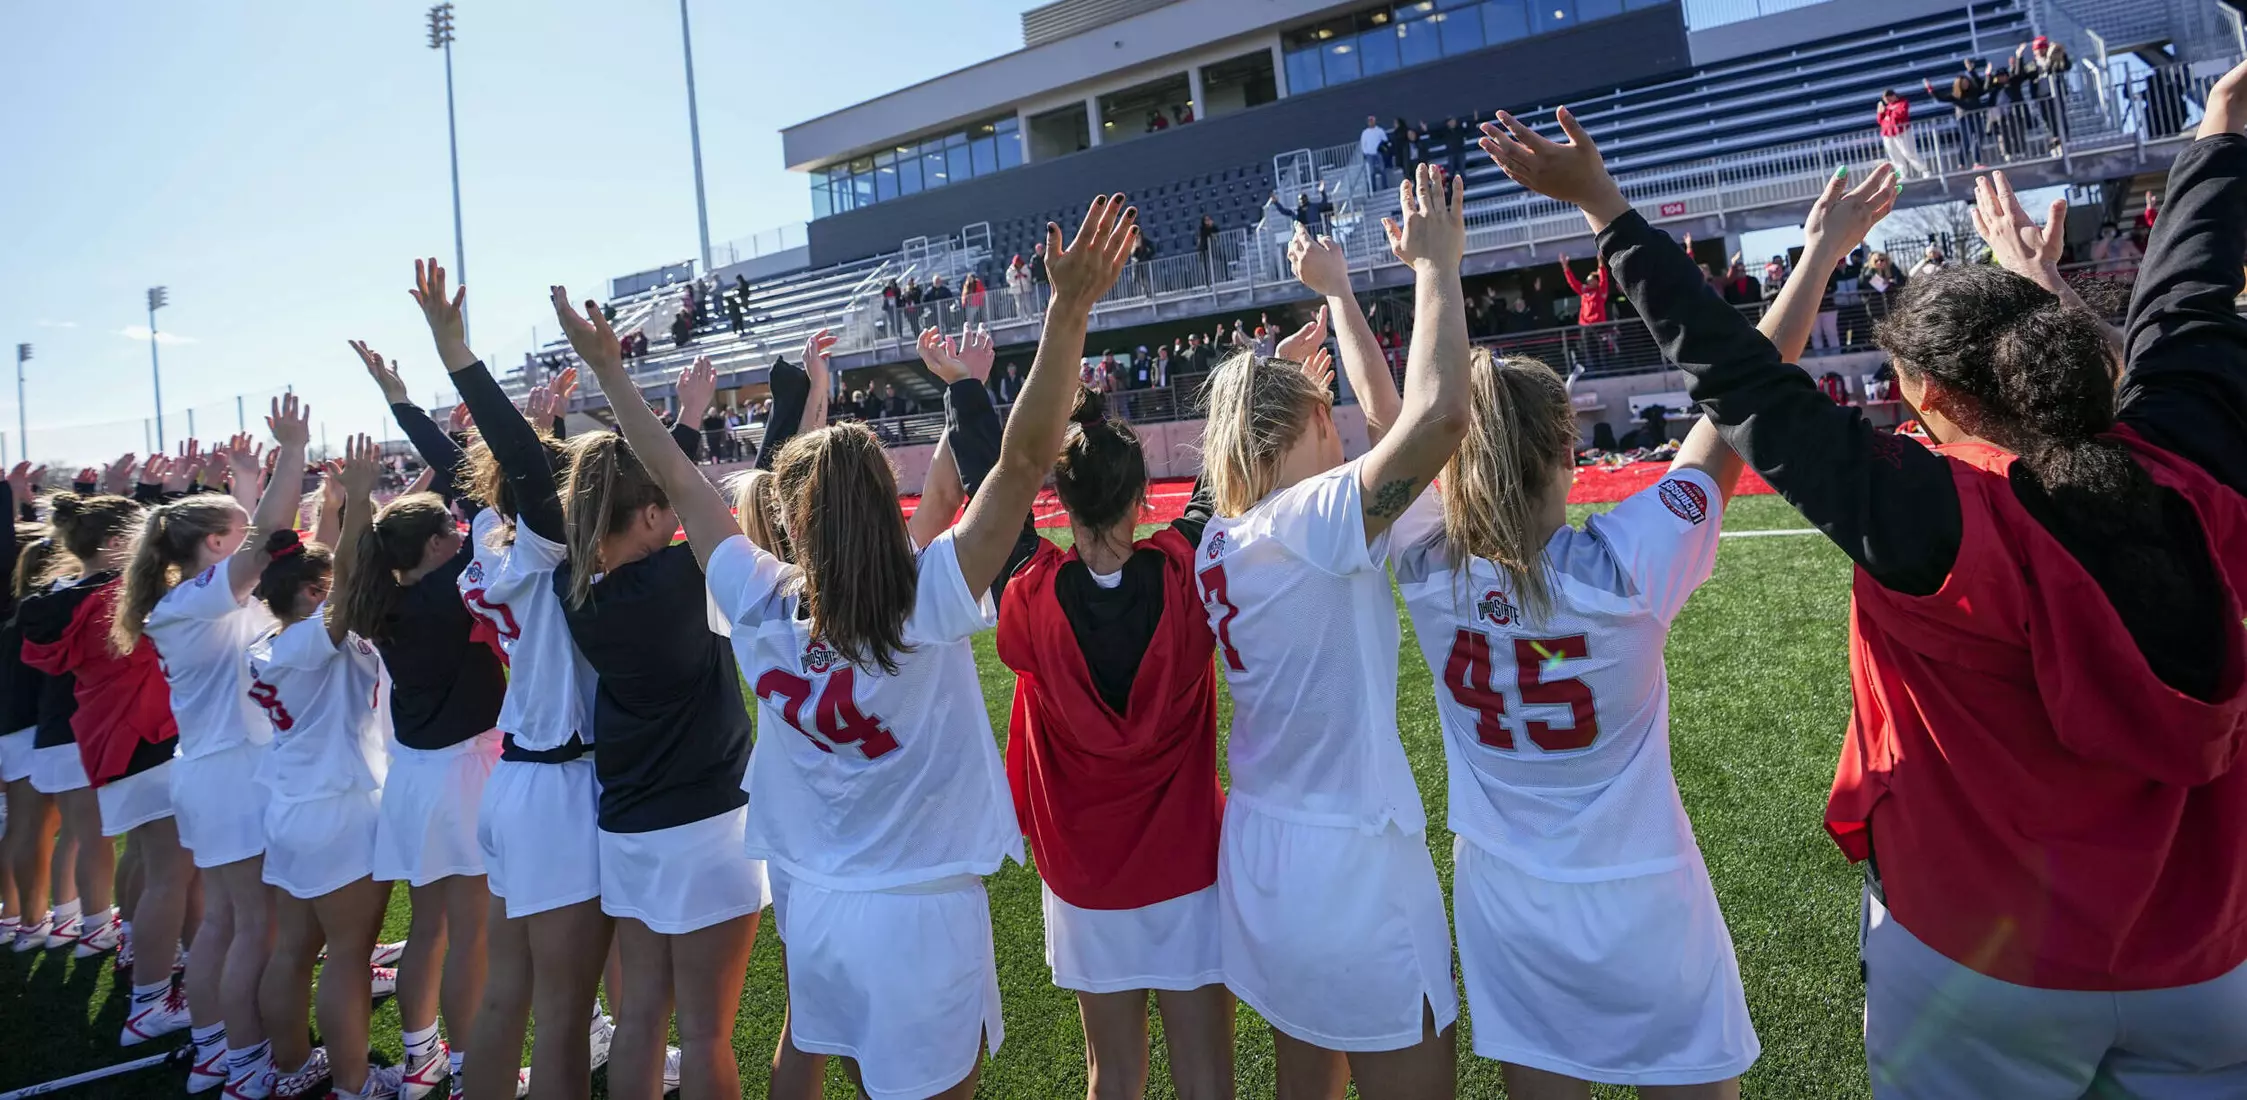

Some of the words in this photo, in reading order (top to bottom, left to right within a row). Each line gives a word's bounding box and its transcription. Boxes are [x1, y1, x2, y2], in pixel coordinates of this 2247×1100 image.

[1663, 204, 1682, 215] 104
[1660, 480, 1705, 523] LACROSSE
[1478, 601, 1495, 620] OHIO
[1494, 600, 1520, 627] STATE
[814, 650, 838, 667] STATE
[1443, 627, 1601, 753] 45
[755, 665, 904, 760] 24
